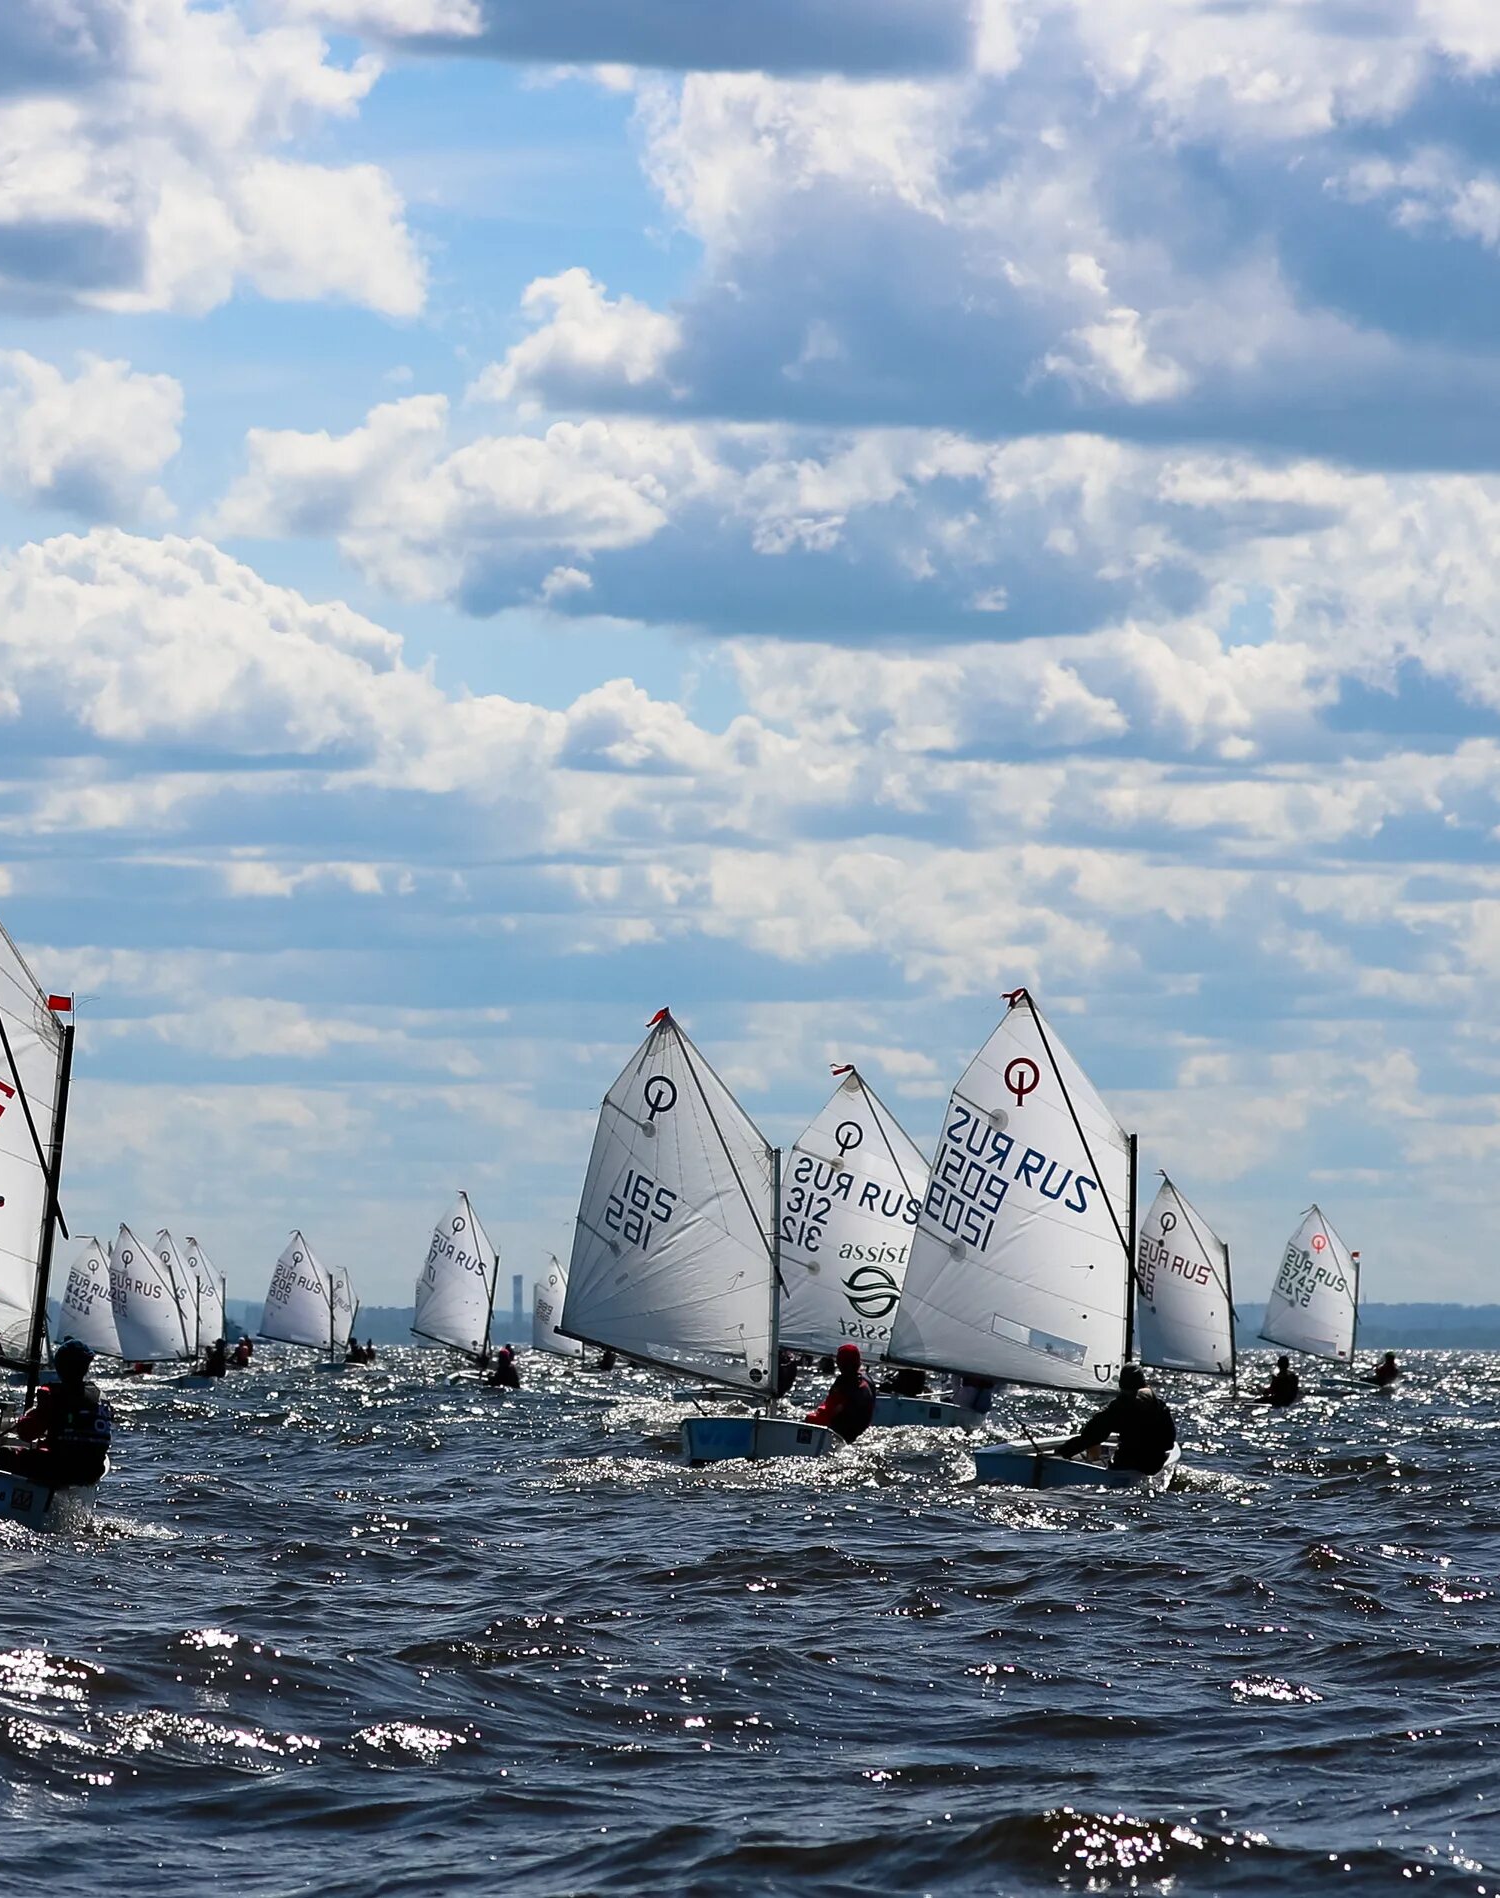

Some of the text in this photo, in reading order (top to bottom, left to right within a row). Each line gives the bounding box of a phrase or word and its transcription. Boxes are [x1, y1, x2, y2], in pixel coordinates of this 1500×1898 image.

[935, 1143, 1009, 1214] 1209
[1015, 1148, 1097, 1213] RUS
[623, 1169, 677, 1223] 165
[786, 1187, 832, 1226] 312
[859, 1182, 922, 1225] RUS
[455, 1250, 487, 1276] RUS
[839, 1241, 908, 1263] assist
[1171, 1255, 1211, 1285] RUS
[1282, 1263, 1316, 1293] 5743
[1314, 1267, 1347, 1292] RUS
[67, 1284, 94, 1304] 4424
[135, 1280, 162, 1299] RUS
[272, 1275, 292, 1294] 206
[297, 1276, 322, 1294] RUS
